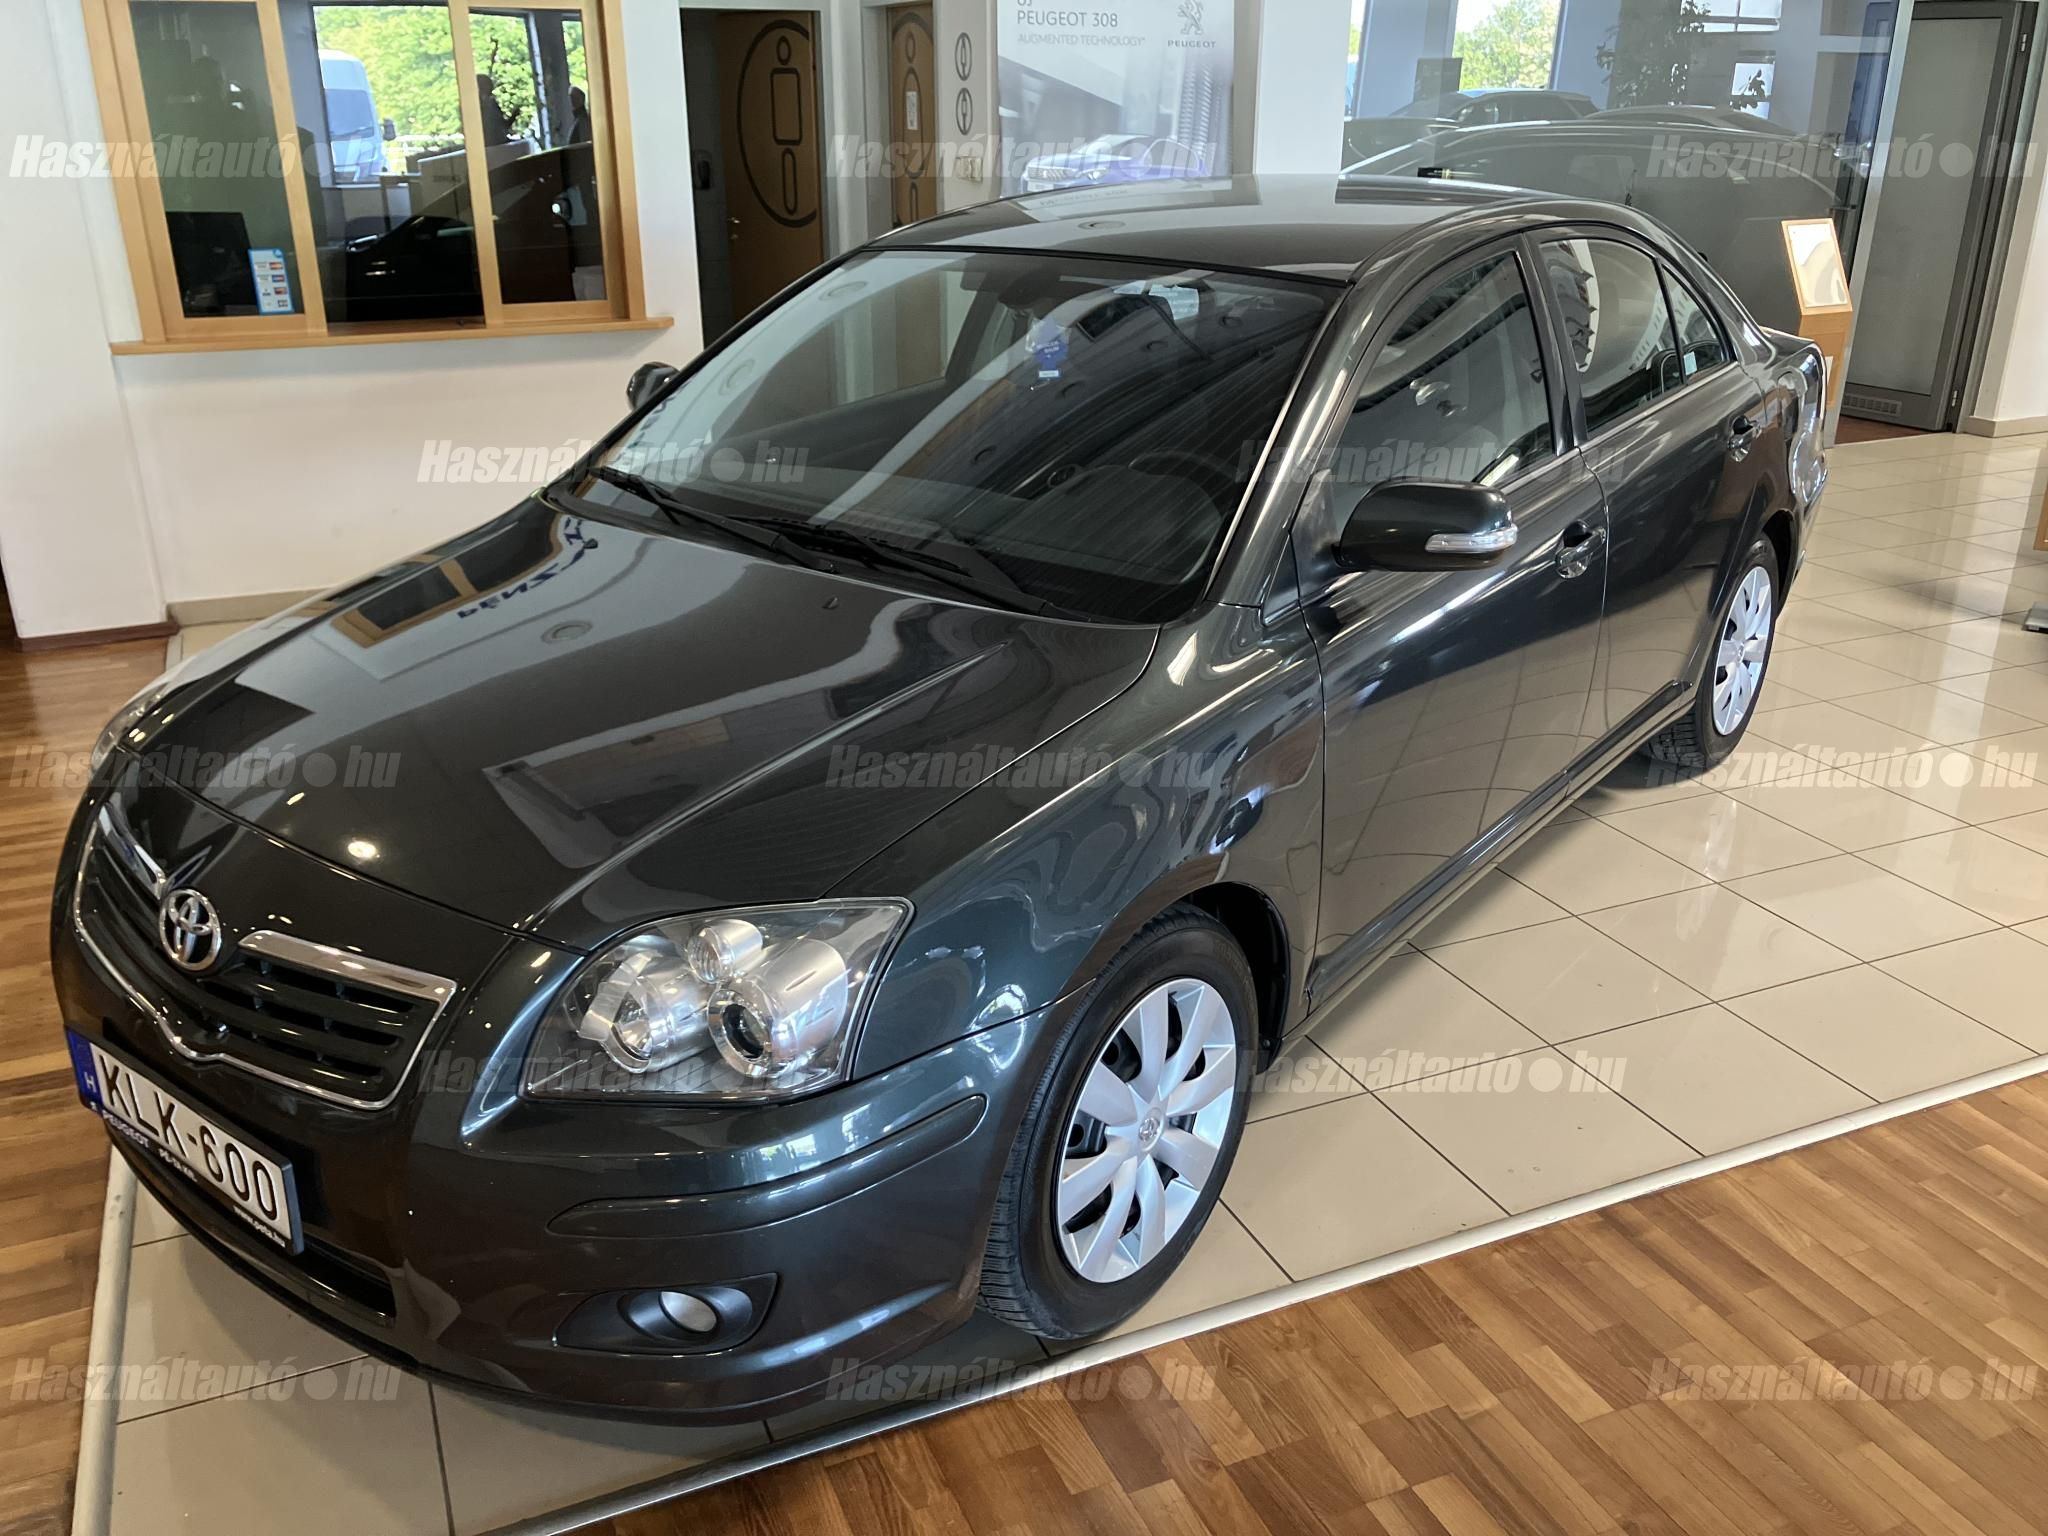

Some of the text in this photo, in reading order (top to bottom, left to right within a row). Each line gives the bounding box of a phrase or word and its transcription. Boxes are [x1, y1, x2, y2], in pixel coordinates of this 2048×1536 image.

[1017, 10, 1118, 28] PEUGEOT 308
[1017, 33, 1079, 46] AUGMENTED
[1167, 39, 1217, 49] PEUGEOT
[84, 1071, 97, 1093] H
[99, 1053, 278, 1221] KLK-600
